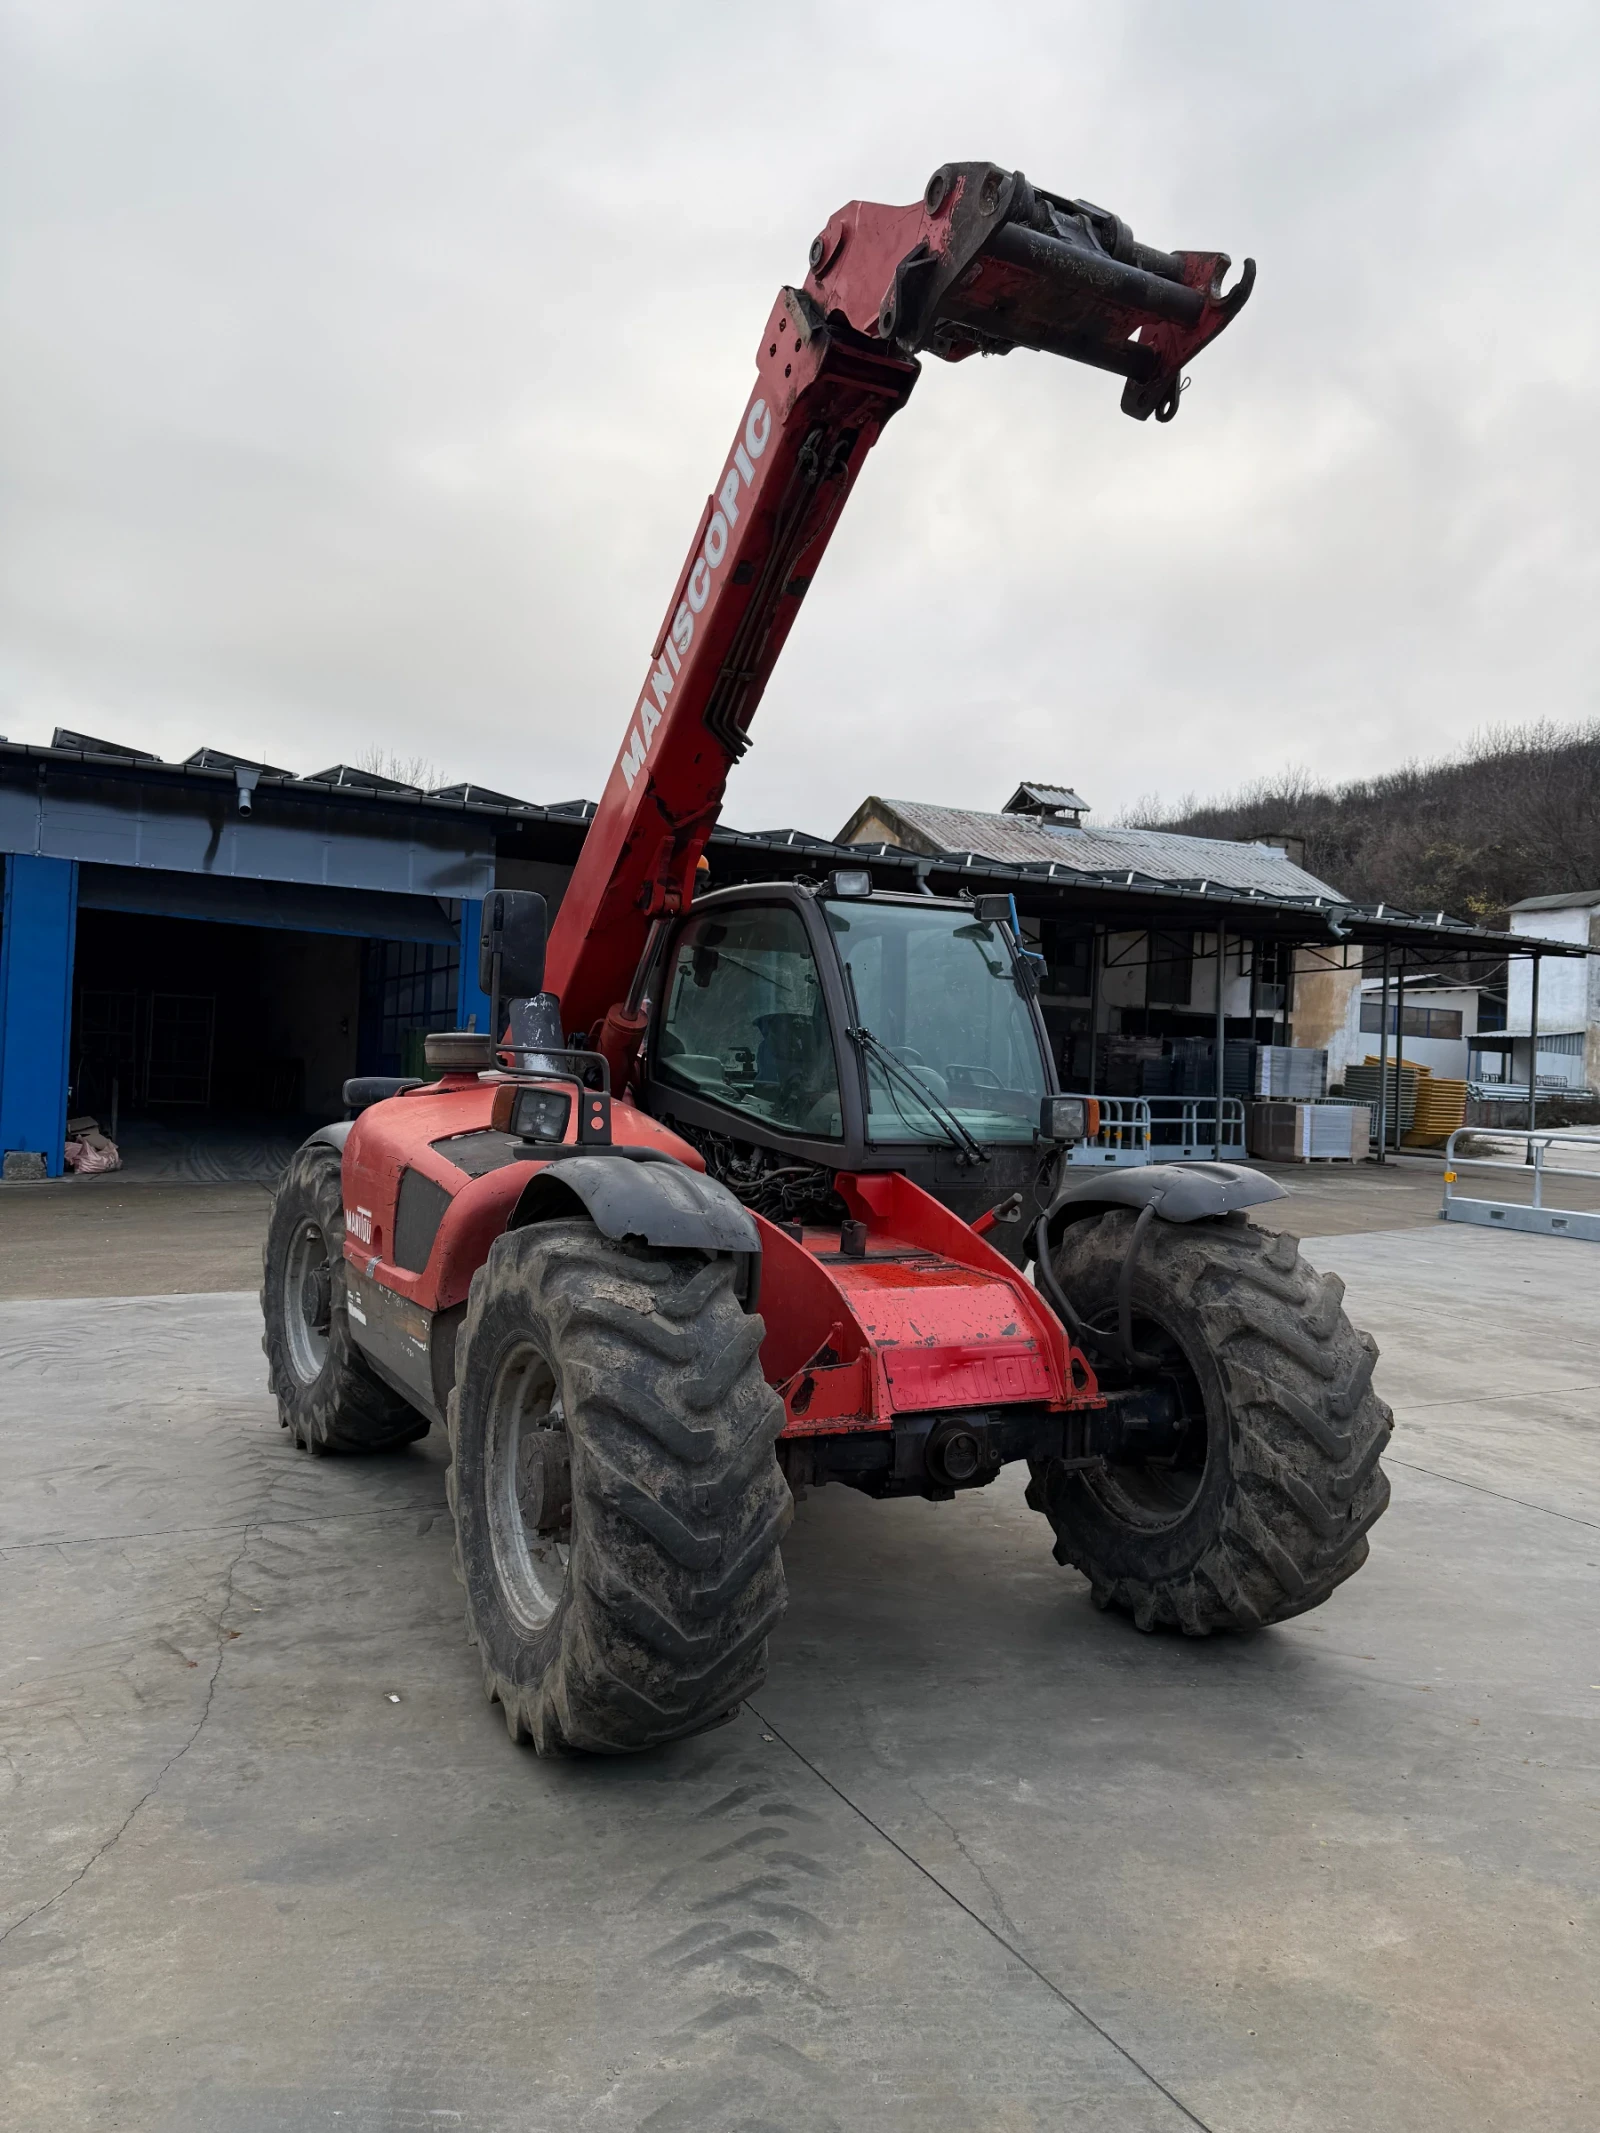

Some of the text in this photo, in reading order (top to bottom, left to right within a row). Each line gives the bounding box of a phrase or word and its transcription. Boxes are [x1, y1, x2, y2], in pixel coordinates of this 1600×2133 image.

[620, 398, 771, 791] MANISCOPIC
[345, 1205, 372, 1245] MANITOU
[889, 1343, 1051, 1406] MANITOU
